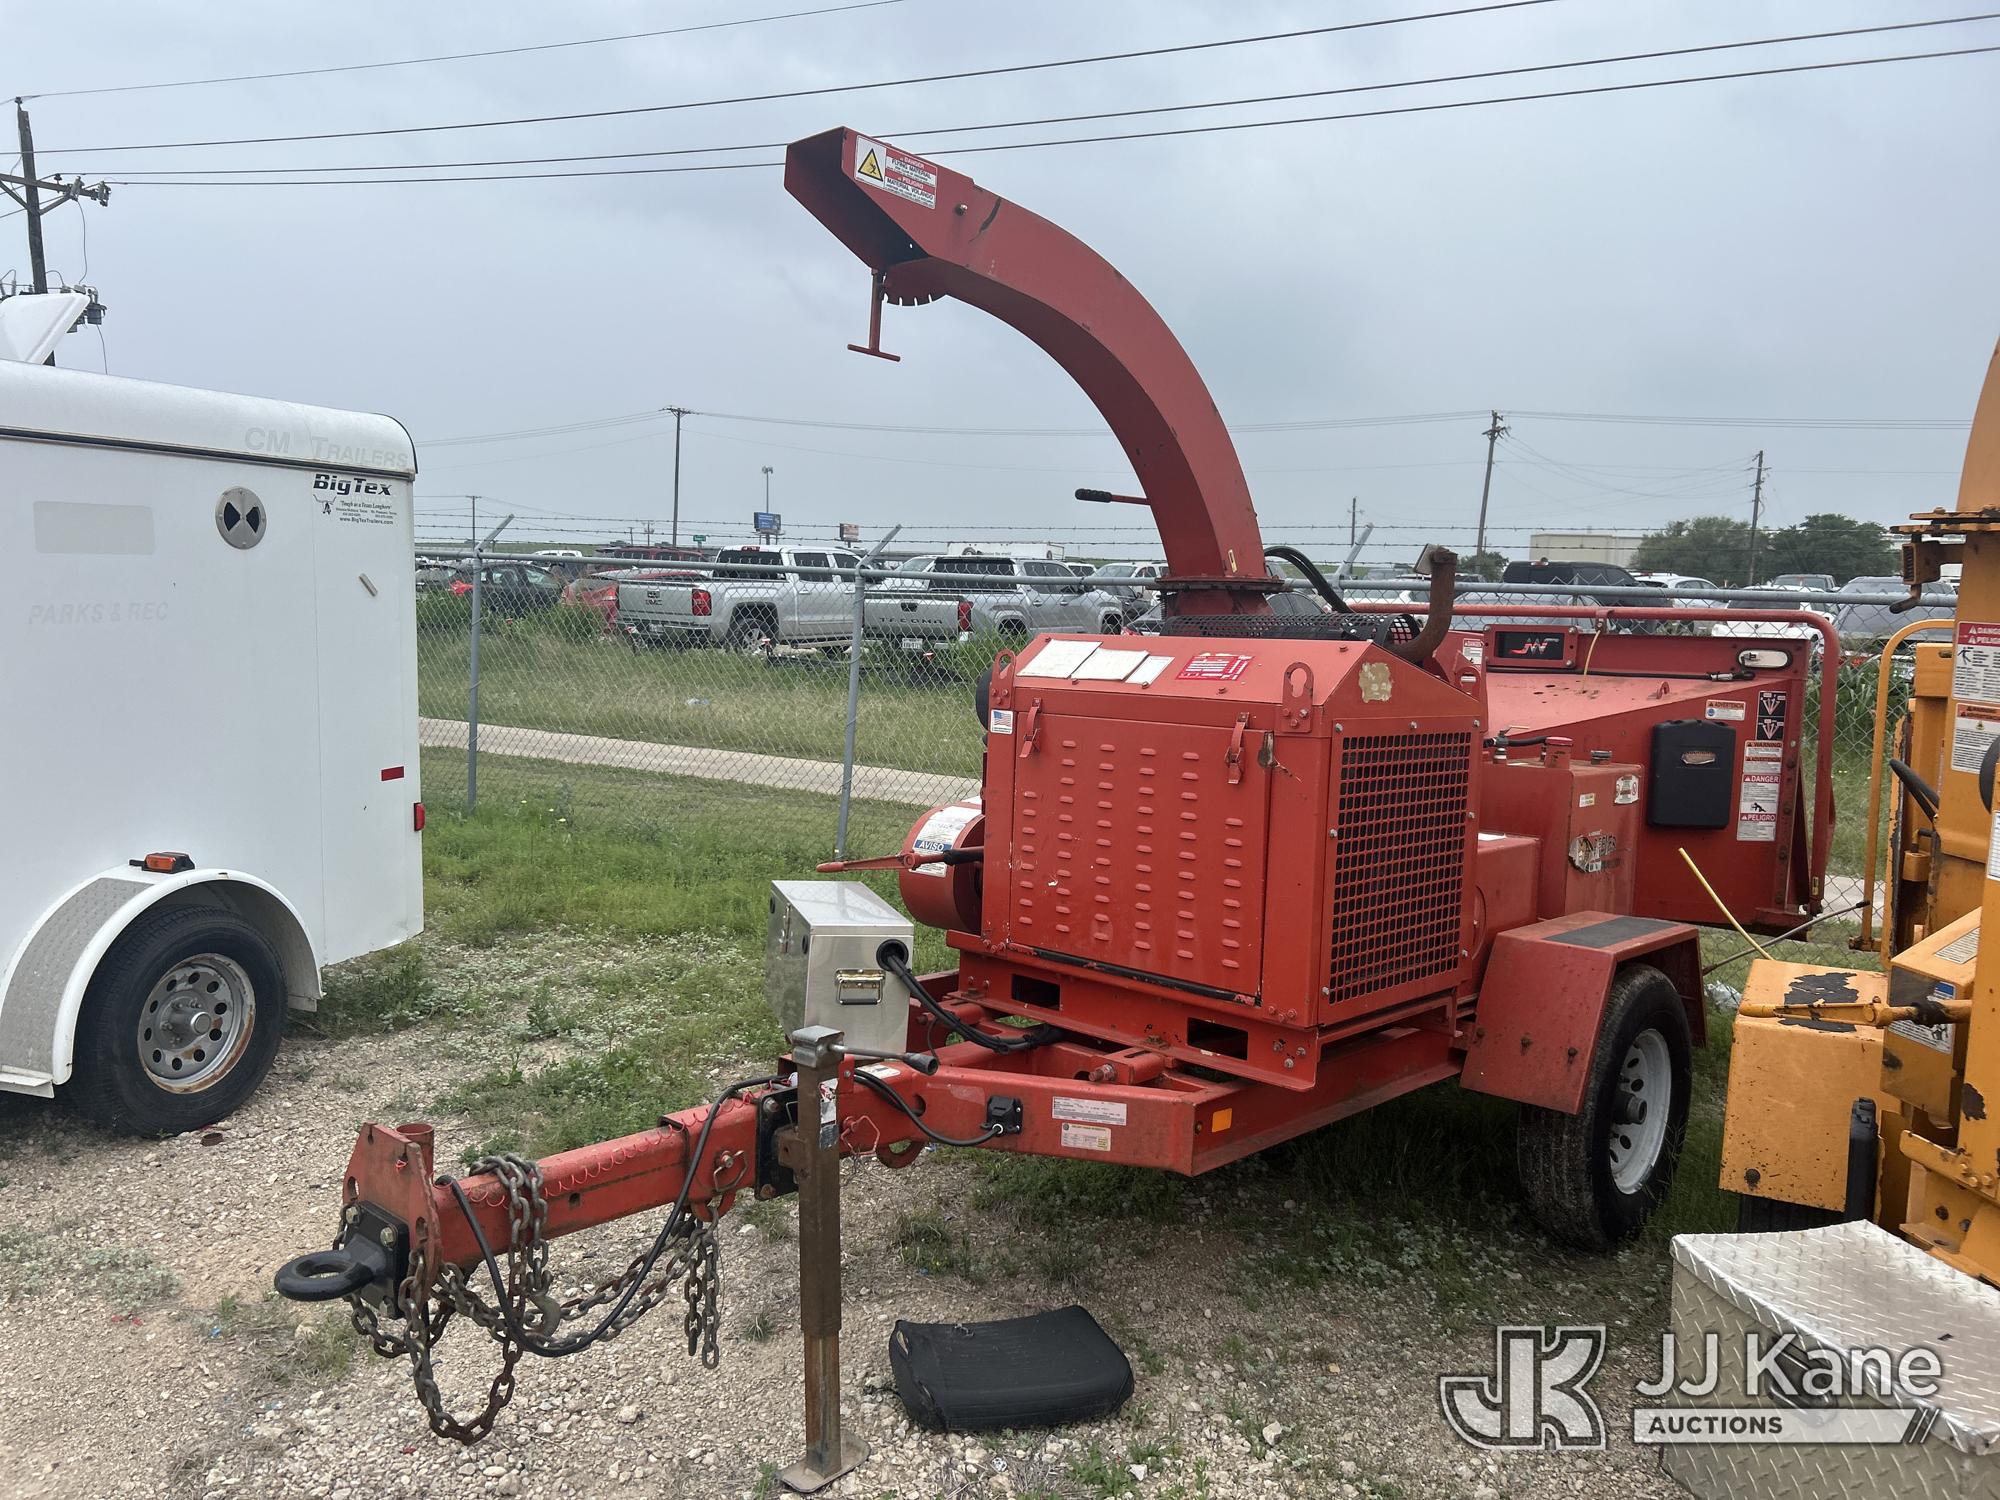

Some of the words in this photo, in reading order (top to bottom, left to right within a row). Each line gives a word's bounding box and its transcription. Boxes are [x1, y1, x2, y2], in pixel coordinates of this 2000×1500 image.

[244, 427, 291, 454] CM
[312, 437, 408, 467] TRAILERS
[27, 602, 104, 625] PARKS
[110, 601, 121, 622] &
[128, 600, 170, 622] REC
[1751, 775, 1779, 783] DANGER
[1747, 814, 1776, 822] PELIGRO
[919, 841, 944, 852] AVISO
